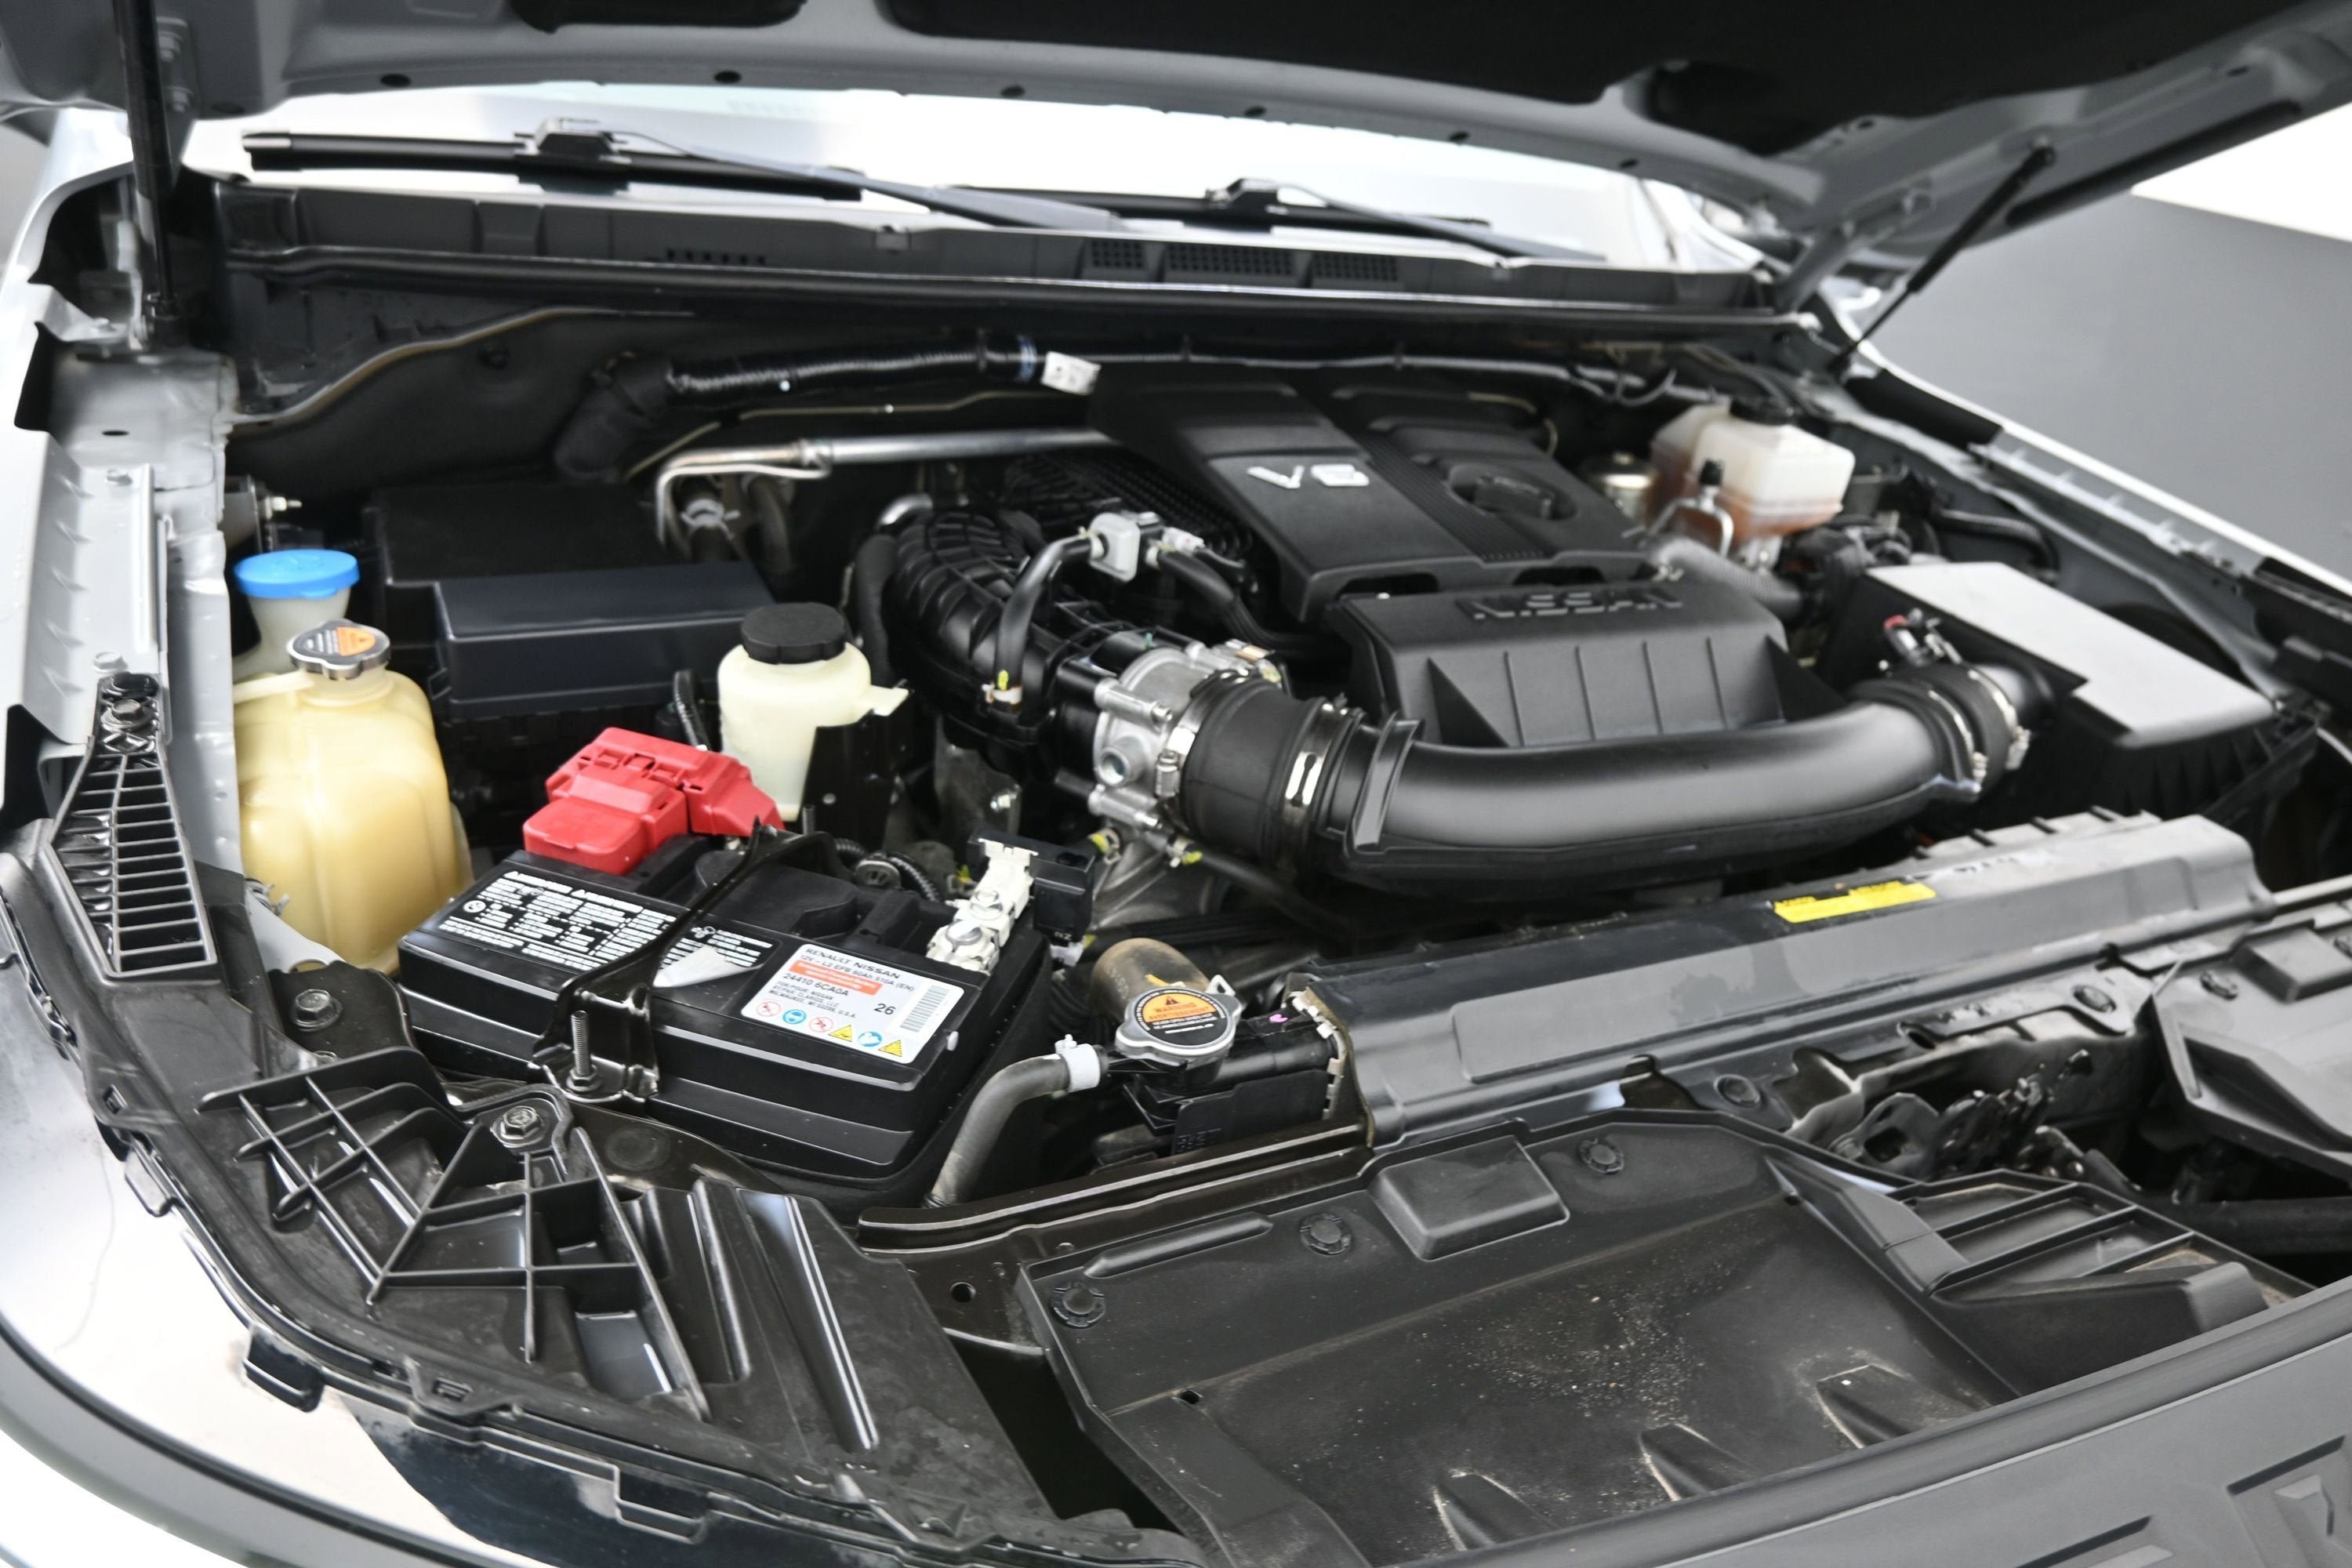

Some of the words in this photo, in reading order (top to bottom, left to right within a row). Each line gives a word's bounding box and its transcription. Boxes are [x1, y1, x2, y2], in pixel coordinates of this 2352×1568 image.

[1247, 463, 1370, 489] V6
[804, 949, 851, 964] RENAULT
[852, 962, 901, 978] NISSAN
[782, 972, 814, 985] 24410
[895, 982, 915, 991] (EN)
[873, 1003, 896, 1014] 26
